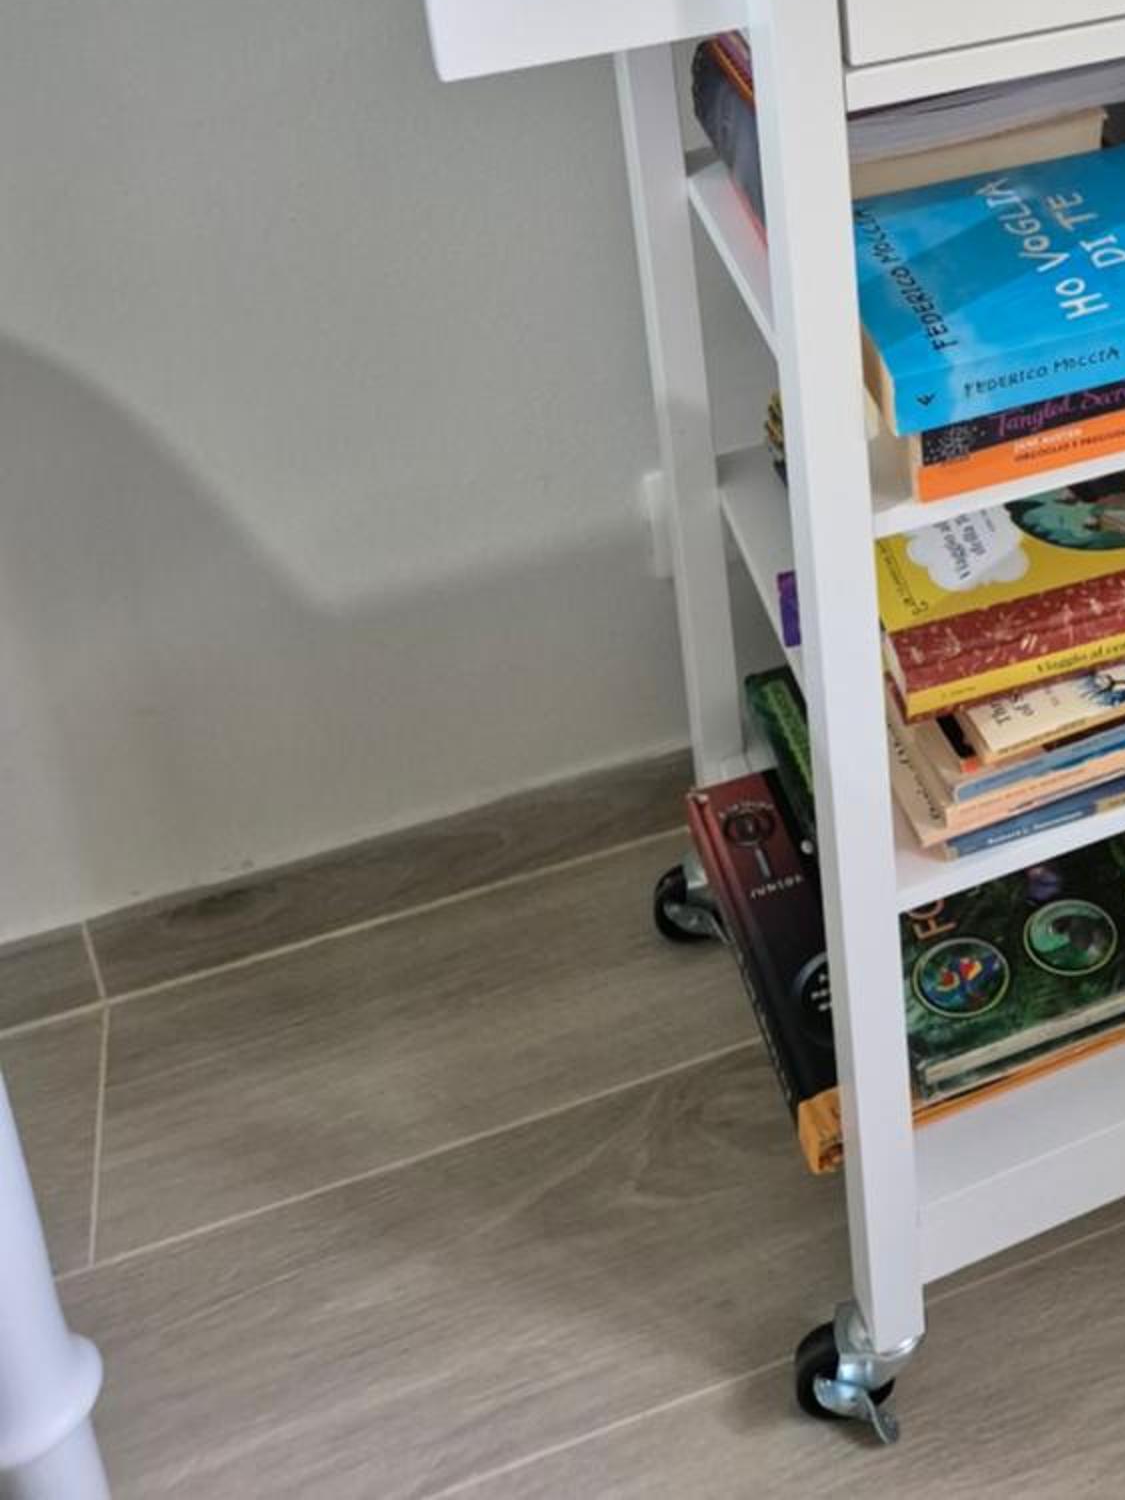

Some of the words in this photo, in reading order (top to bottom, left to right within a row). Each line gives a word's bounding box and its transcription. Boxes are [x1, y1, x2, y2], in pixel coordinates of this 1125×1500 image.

[976, 177, 1071, 273] VOGLIA
[1043, 192, 1099, 231] TE
[890, 265, 959, 353] FEDERICO
[1056, 277, 1110, 320] HO
[963, 364, 1049, 398] FEDERICO
[1053, 347, 1121, 373] MOCCIA
